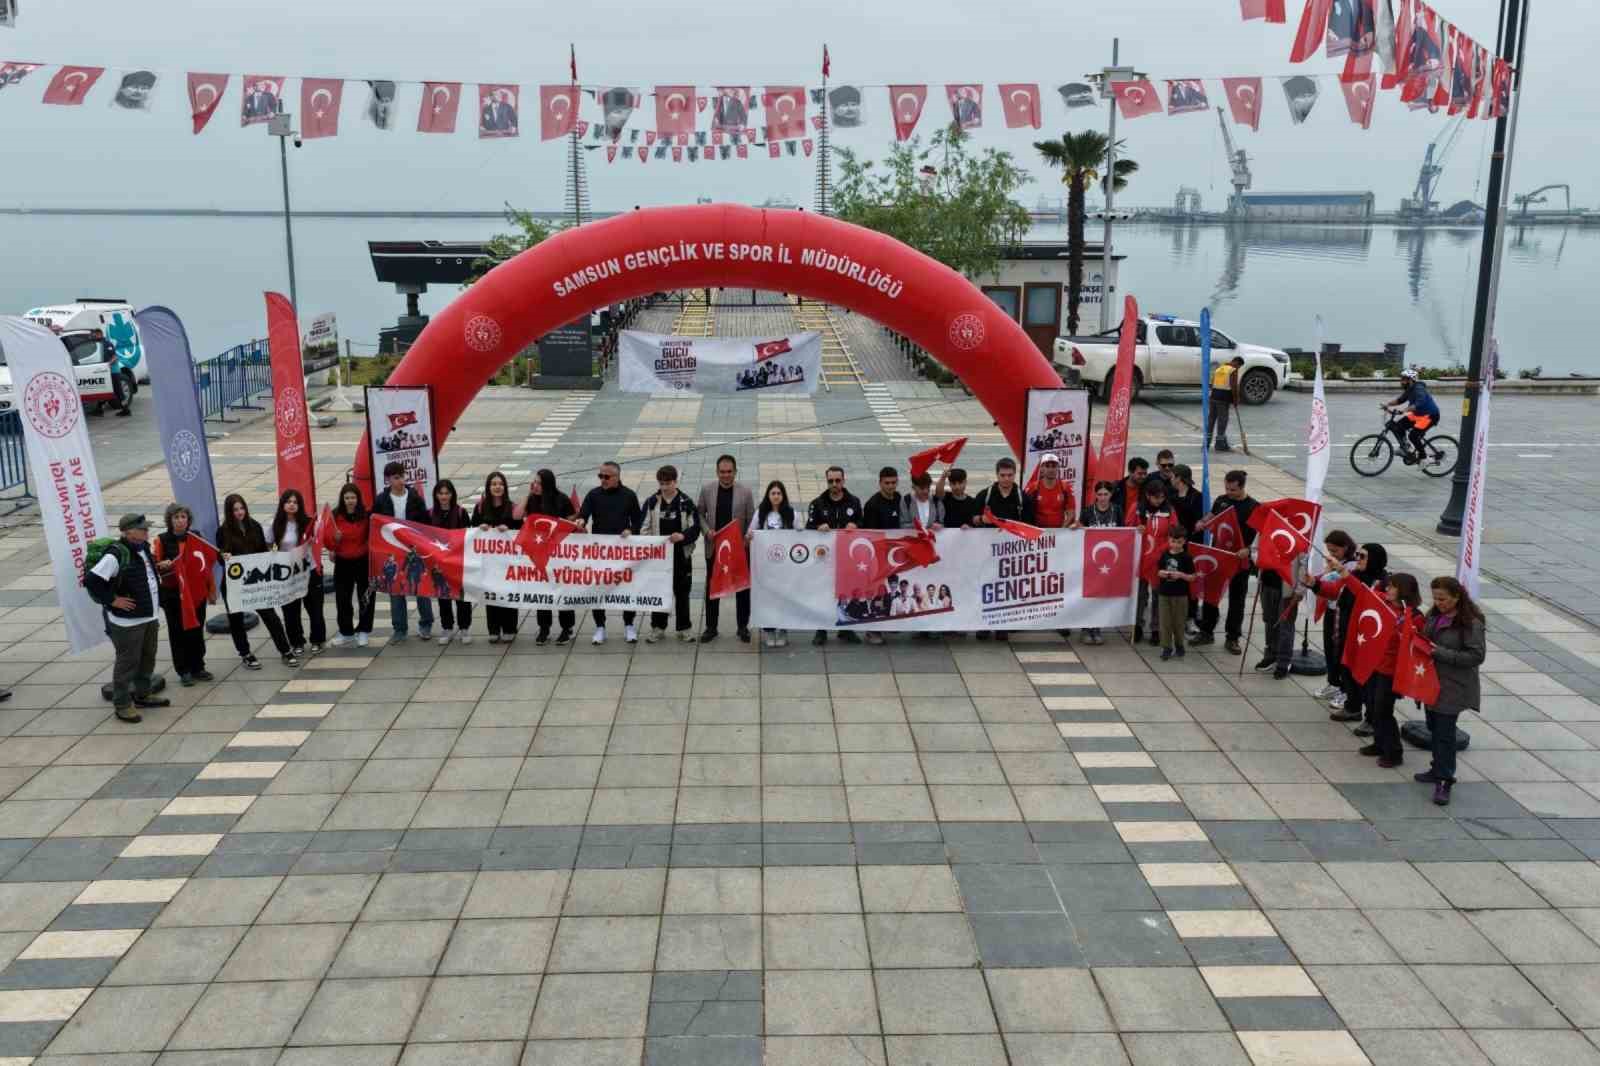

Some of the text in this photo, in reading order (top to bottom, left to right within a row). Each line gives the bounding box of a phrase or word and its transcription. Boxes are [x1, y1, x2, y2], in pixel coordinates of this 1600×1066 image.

[553, 240, 903, 299] SAMSUN GENÇLİK VE SPOR İL MÜDÜRLÜĞÜ
[473, 539, 518, 555] ULUSAL
[582, 542, 666, 561] MÜCADELESİNİ
[505, 565, 633, 586] ANMA YÜRÜYÜŞÜ
[998, 551, 1049, 579] GÜCÜ
[508, 593, 520, 603] 25
[523, 593, 554, 605] MAYIS
[563, 595, 597, 606] SAMSUN
[636, 596, 664, 607] HAVZA
[982, 572, 1065, 605] GENÇLİĞİ
